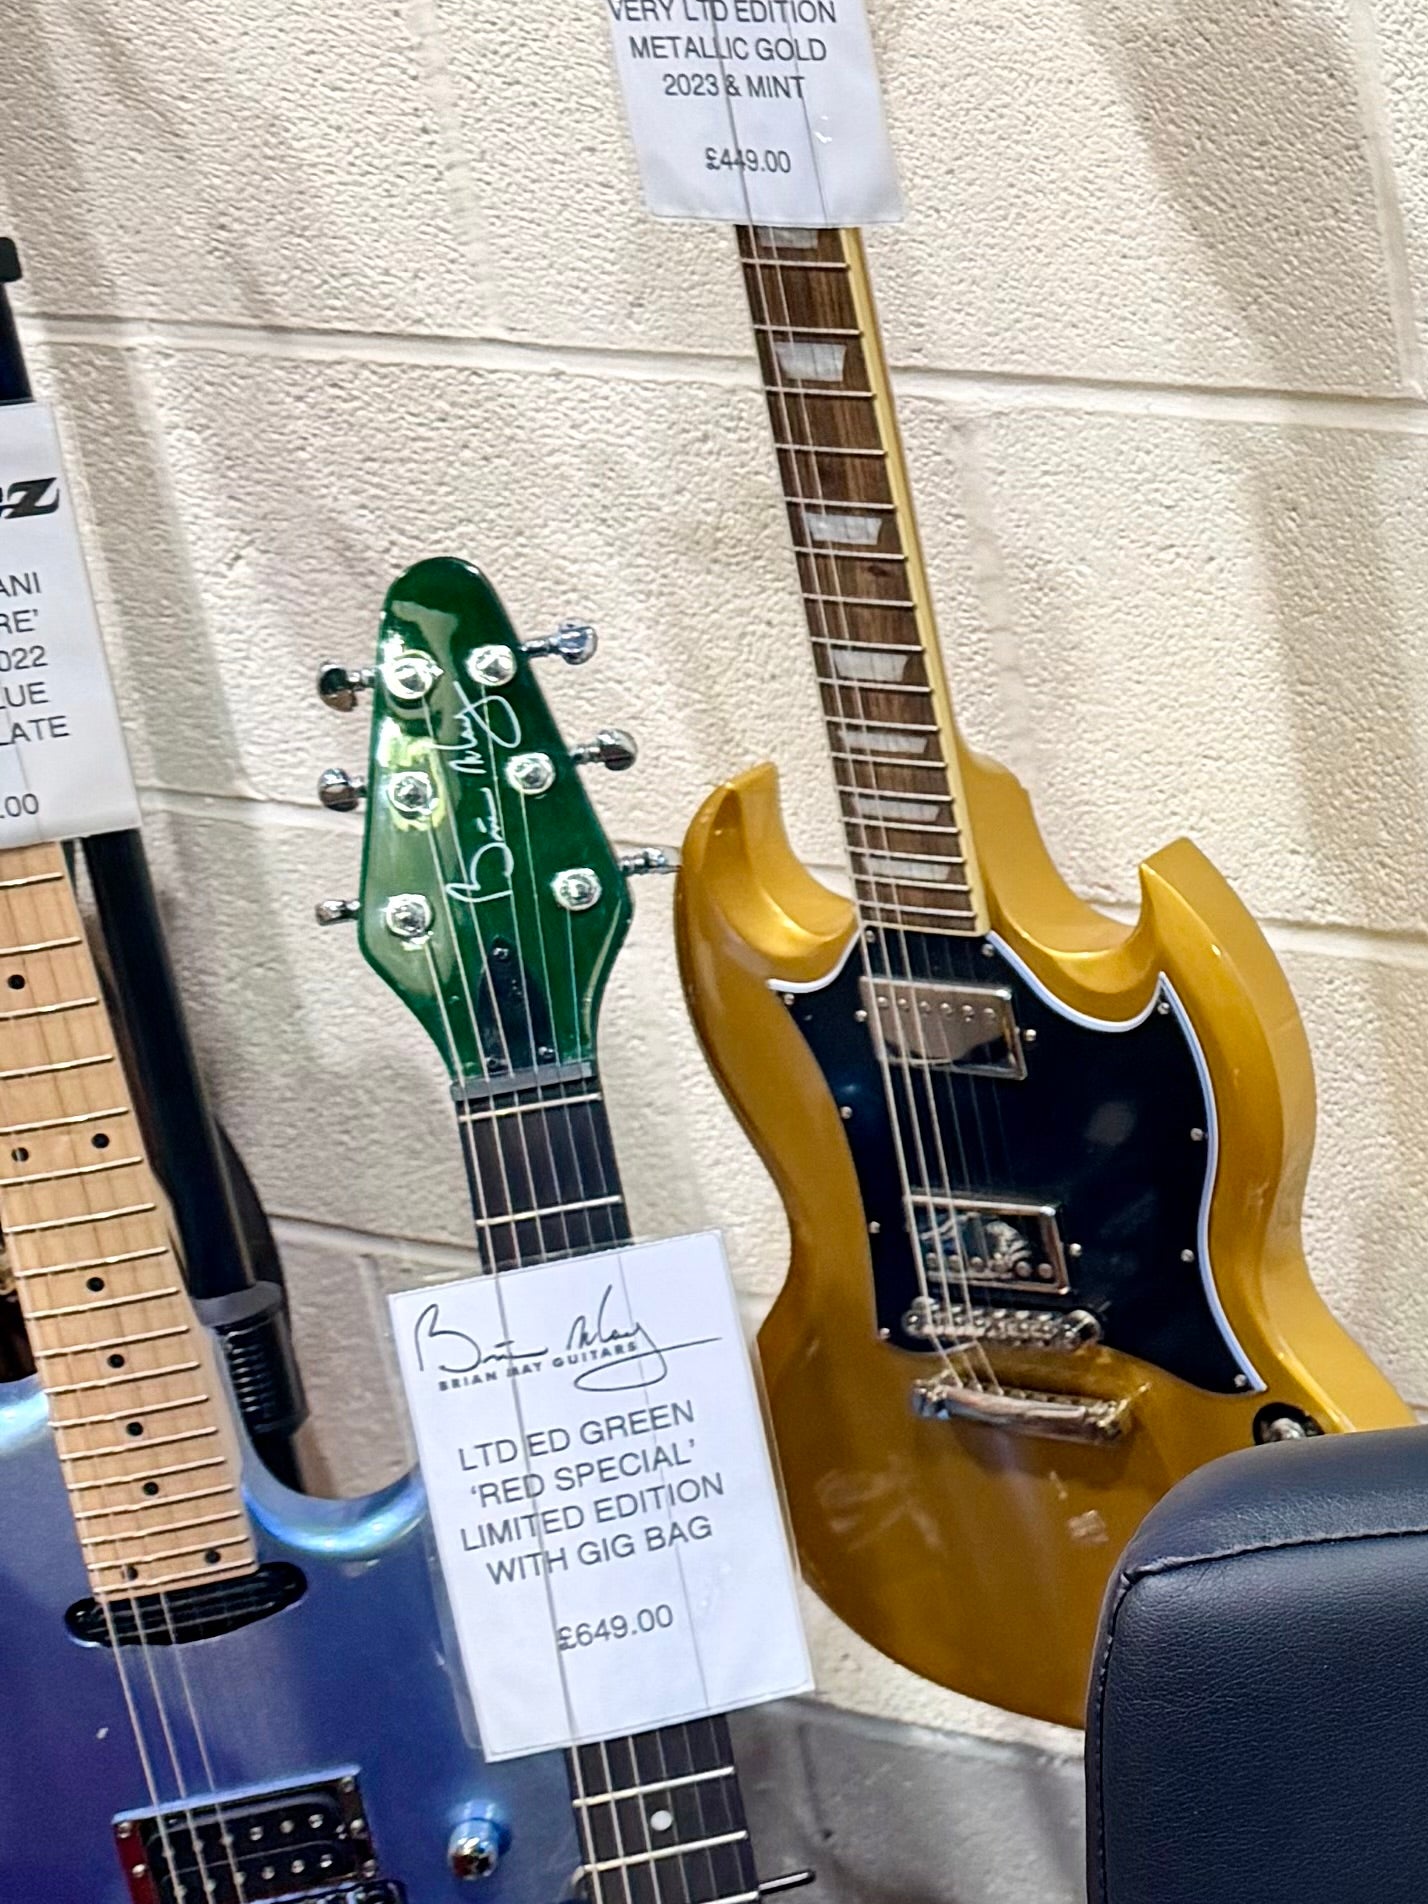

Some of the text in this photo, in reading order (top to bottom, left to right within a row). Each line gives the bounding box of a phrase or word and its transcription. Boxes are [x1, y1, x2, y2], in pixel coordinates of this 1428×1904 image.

[683, 0, 728, 22] LTD
[736, 0, 837, 23] EDITION
[630, 37, 826, 61] METALLIC GOLD
[664, 75, 805, 99] 2023 & MINT
[705, 148, 791, 173] £449.00
[438, 1342, 638, 1392] BRIAN MAY GUITARS
[458, 1401, 695, 1471] LTD ED GREEN
[461, 1473, 724, 1552] LIMITED EDITION
[486, 1517, 713, 1584] WITH GIG BAG
[558, 1604, 674, 1650] £649.00
